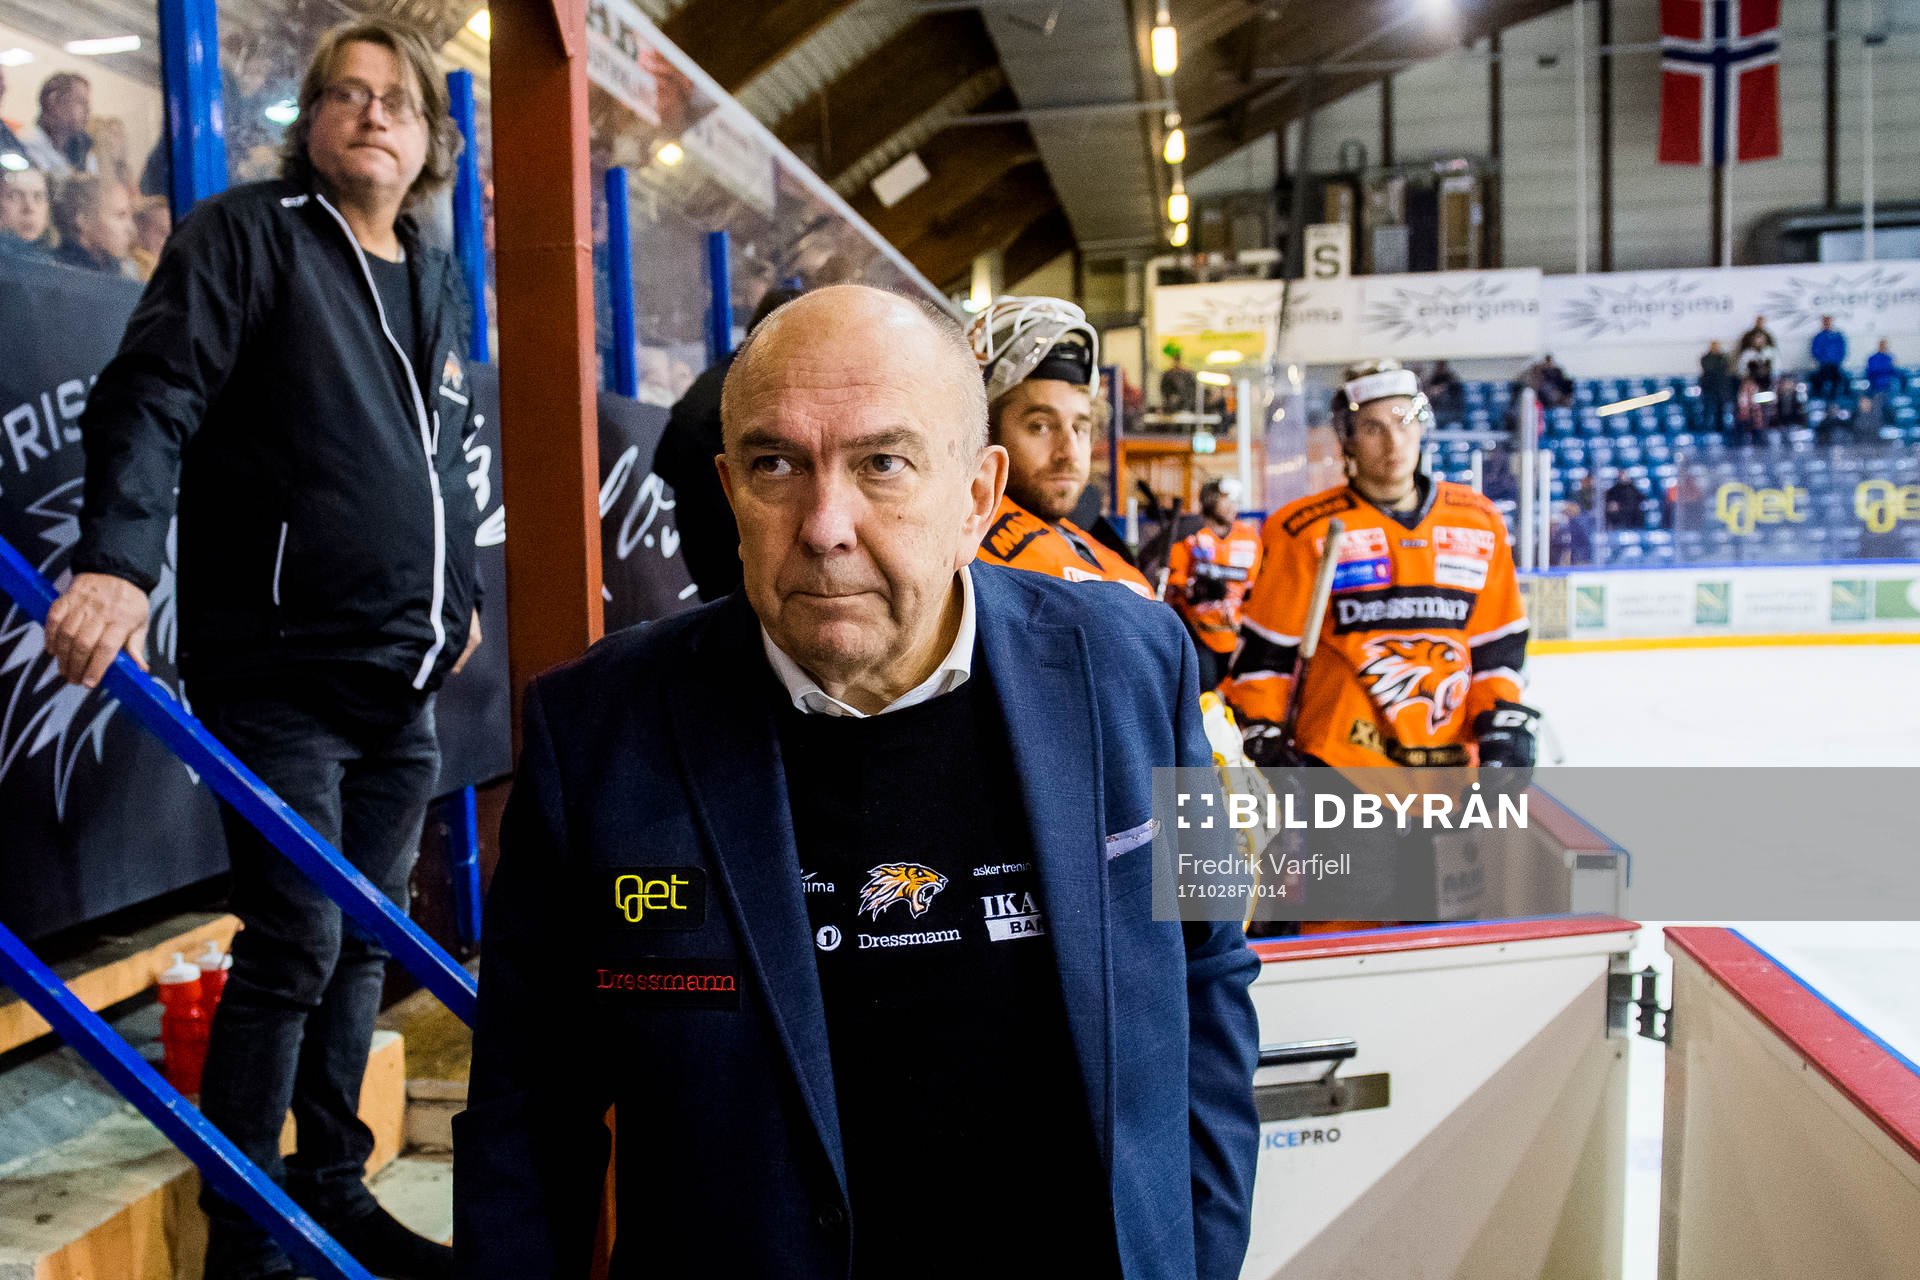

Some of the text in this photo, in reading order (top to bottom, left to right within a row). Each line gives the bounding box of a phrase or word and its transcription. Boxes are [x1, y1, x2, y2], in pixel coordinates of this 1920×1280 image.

[1314, 244, 1340, 279] S
[972, 863, 1000, 877] asker
[858, 928, 962, 949] Dressmann
[597, 968, 737, 991] Dressmann
